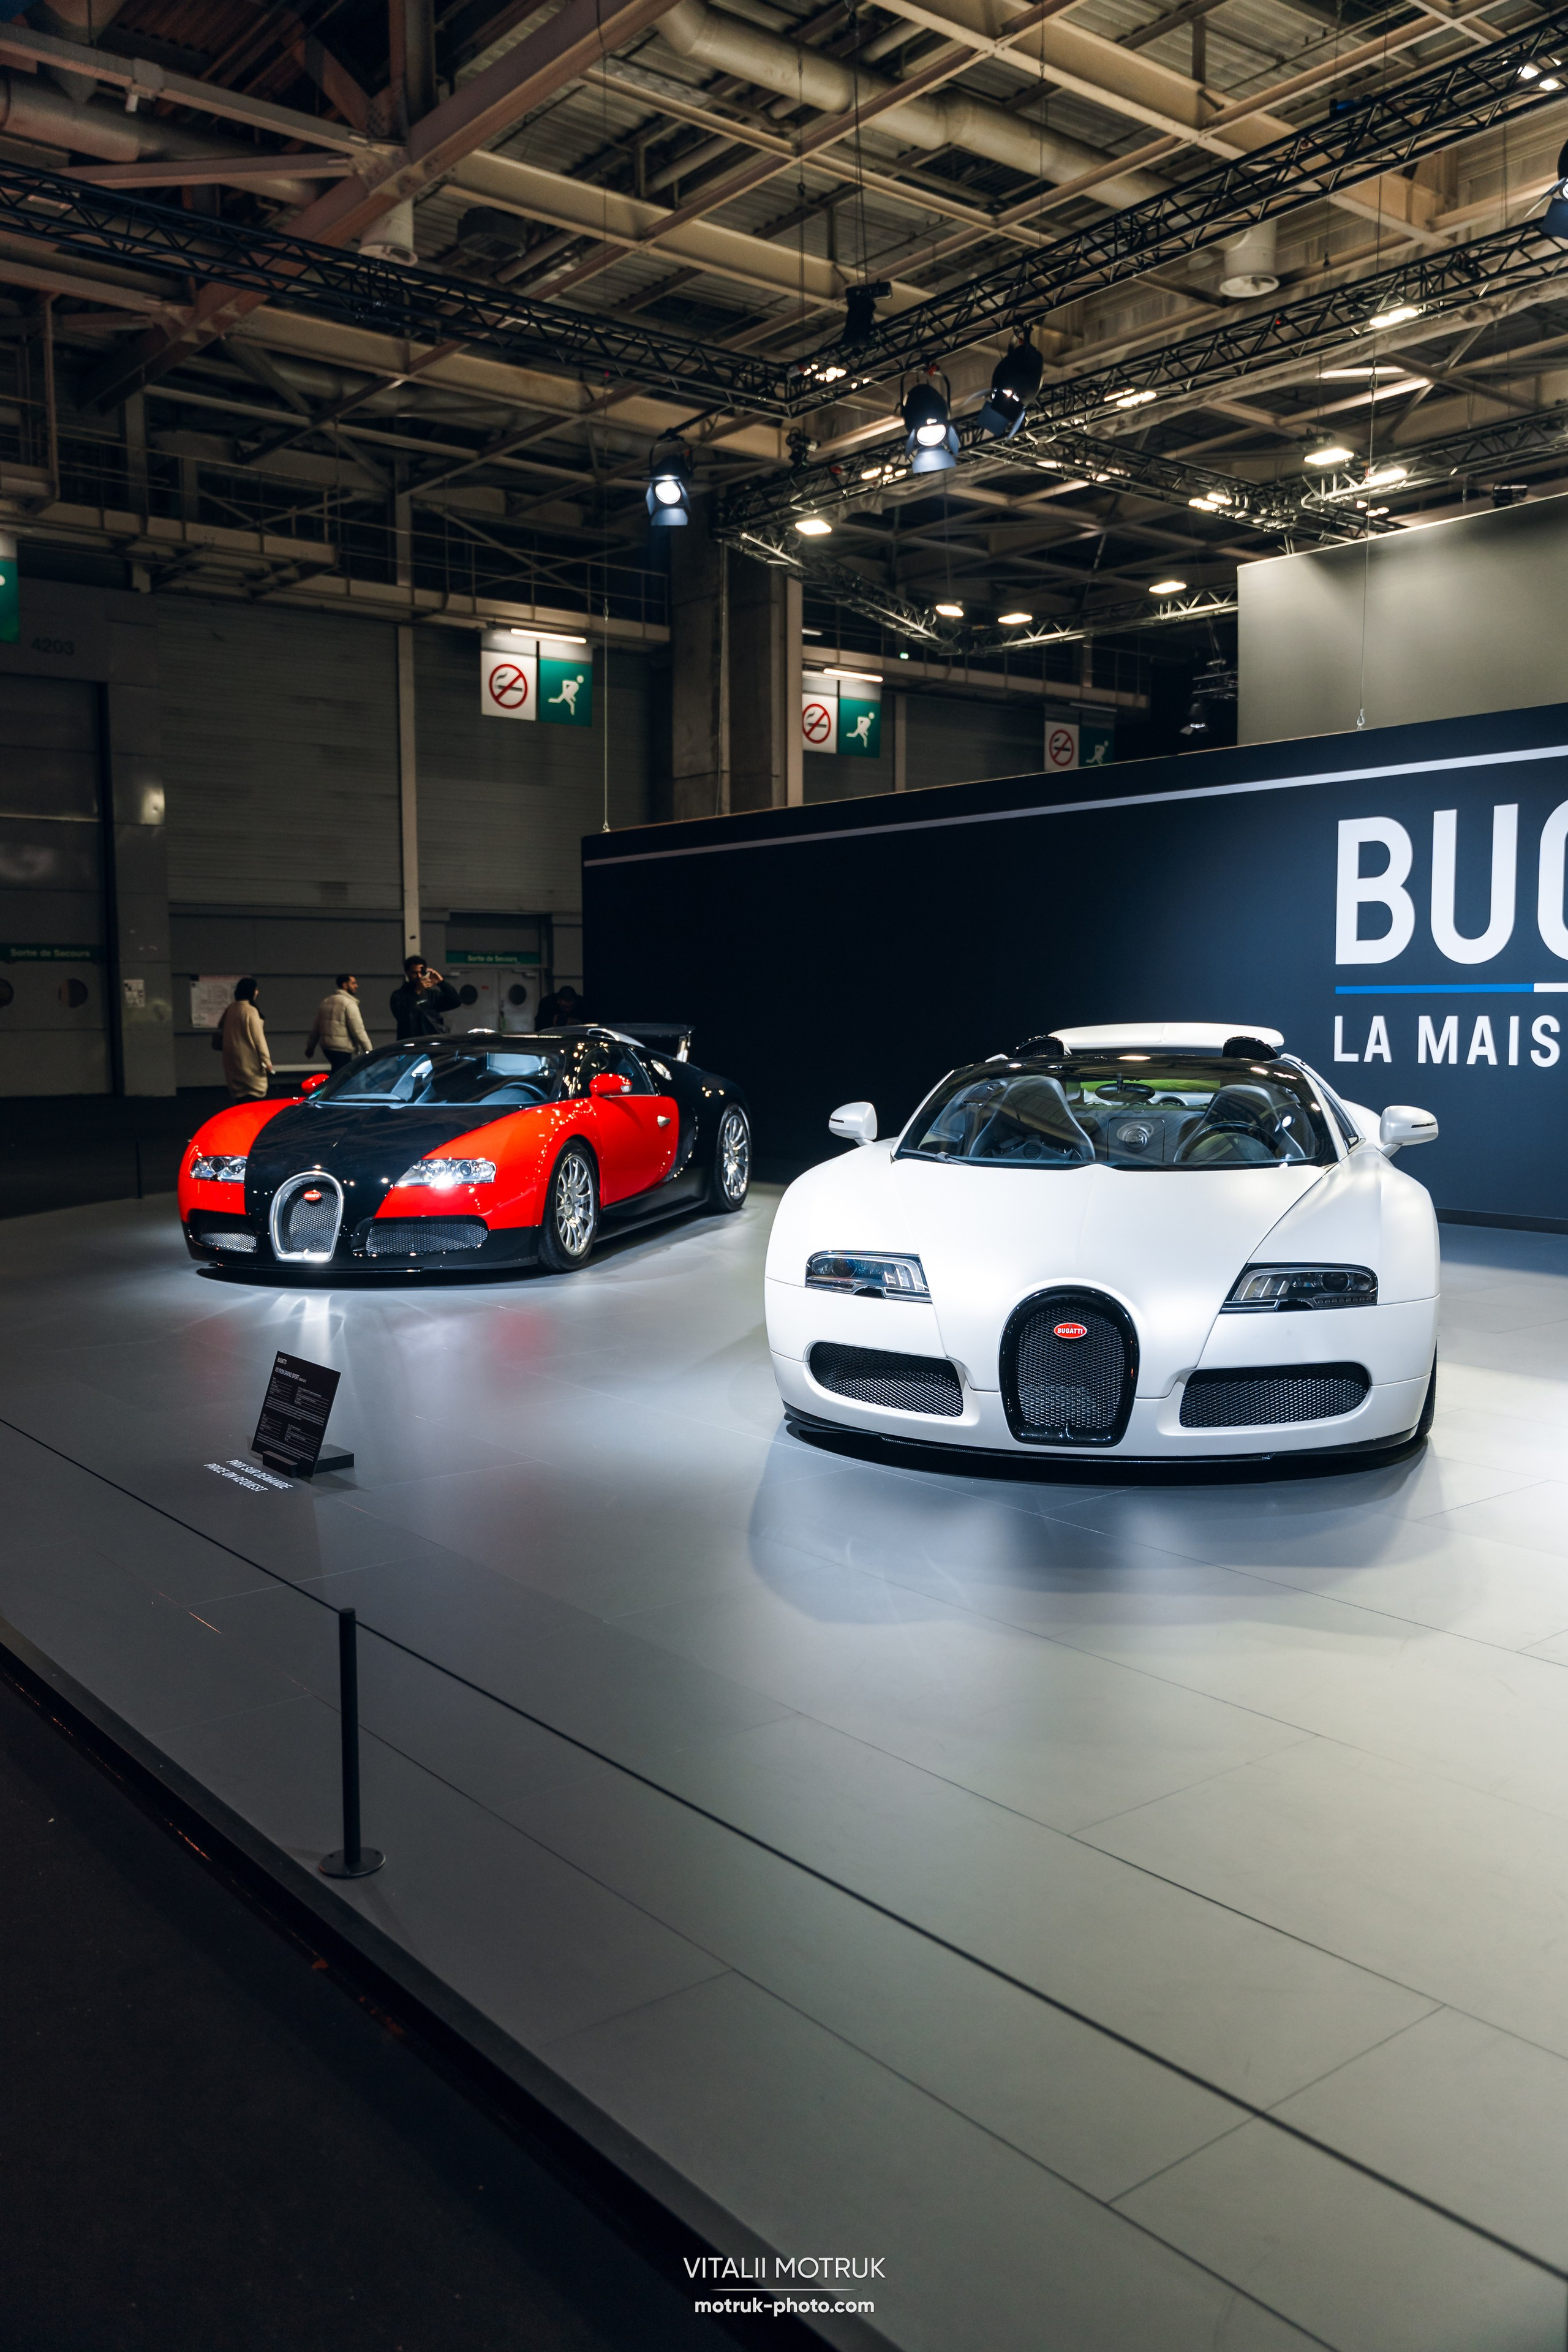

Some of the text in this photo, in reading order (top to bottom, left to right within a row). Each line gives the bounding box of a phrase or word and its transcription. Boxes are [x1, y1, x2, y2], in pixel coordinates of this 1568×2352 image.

[10, 949, 90, 957] Sortie de Secours
[1334, 1014, 1561, 1068] LA MAIS
[203, 1463, 230, 1474] PRICE
[230, 1476, 269, 1492] REQUEST
[225, 1460, 249, 1468] PRIX
[253, 1472, 293, 1489] DEMANDE
